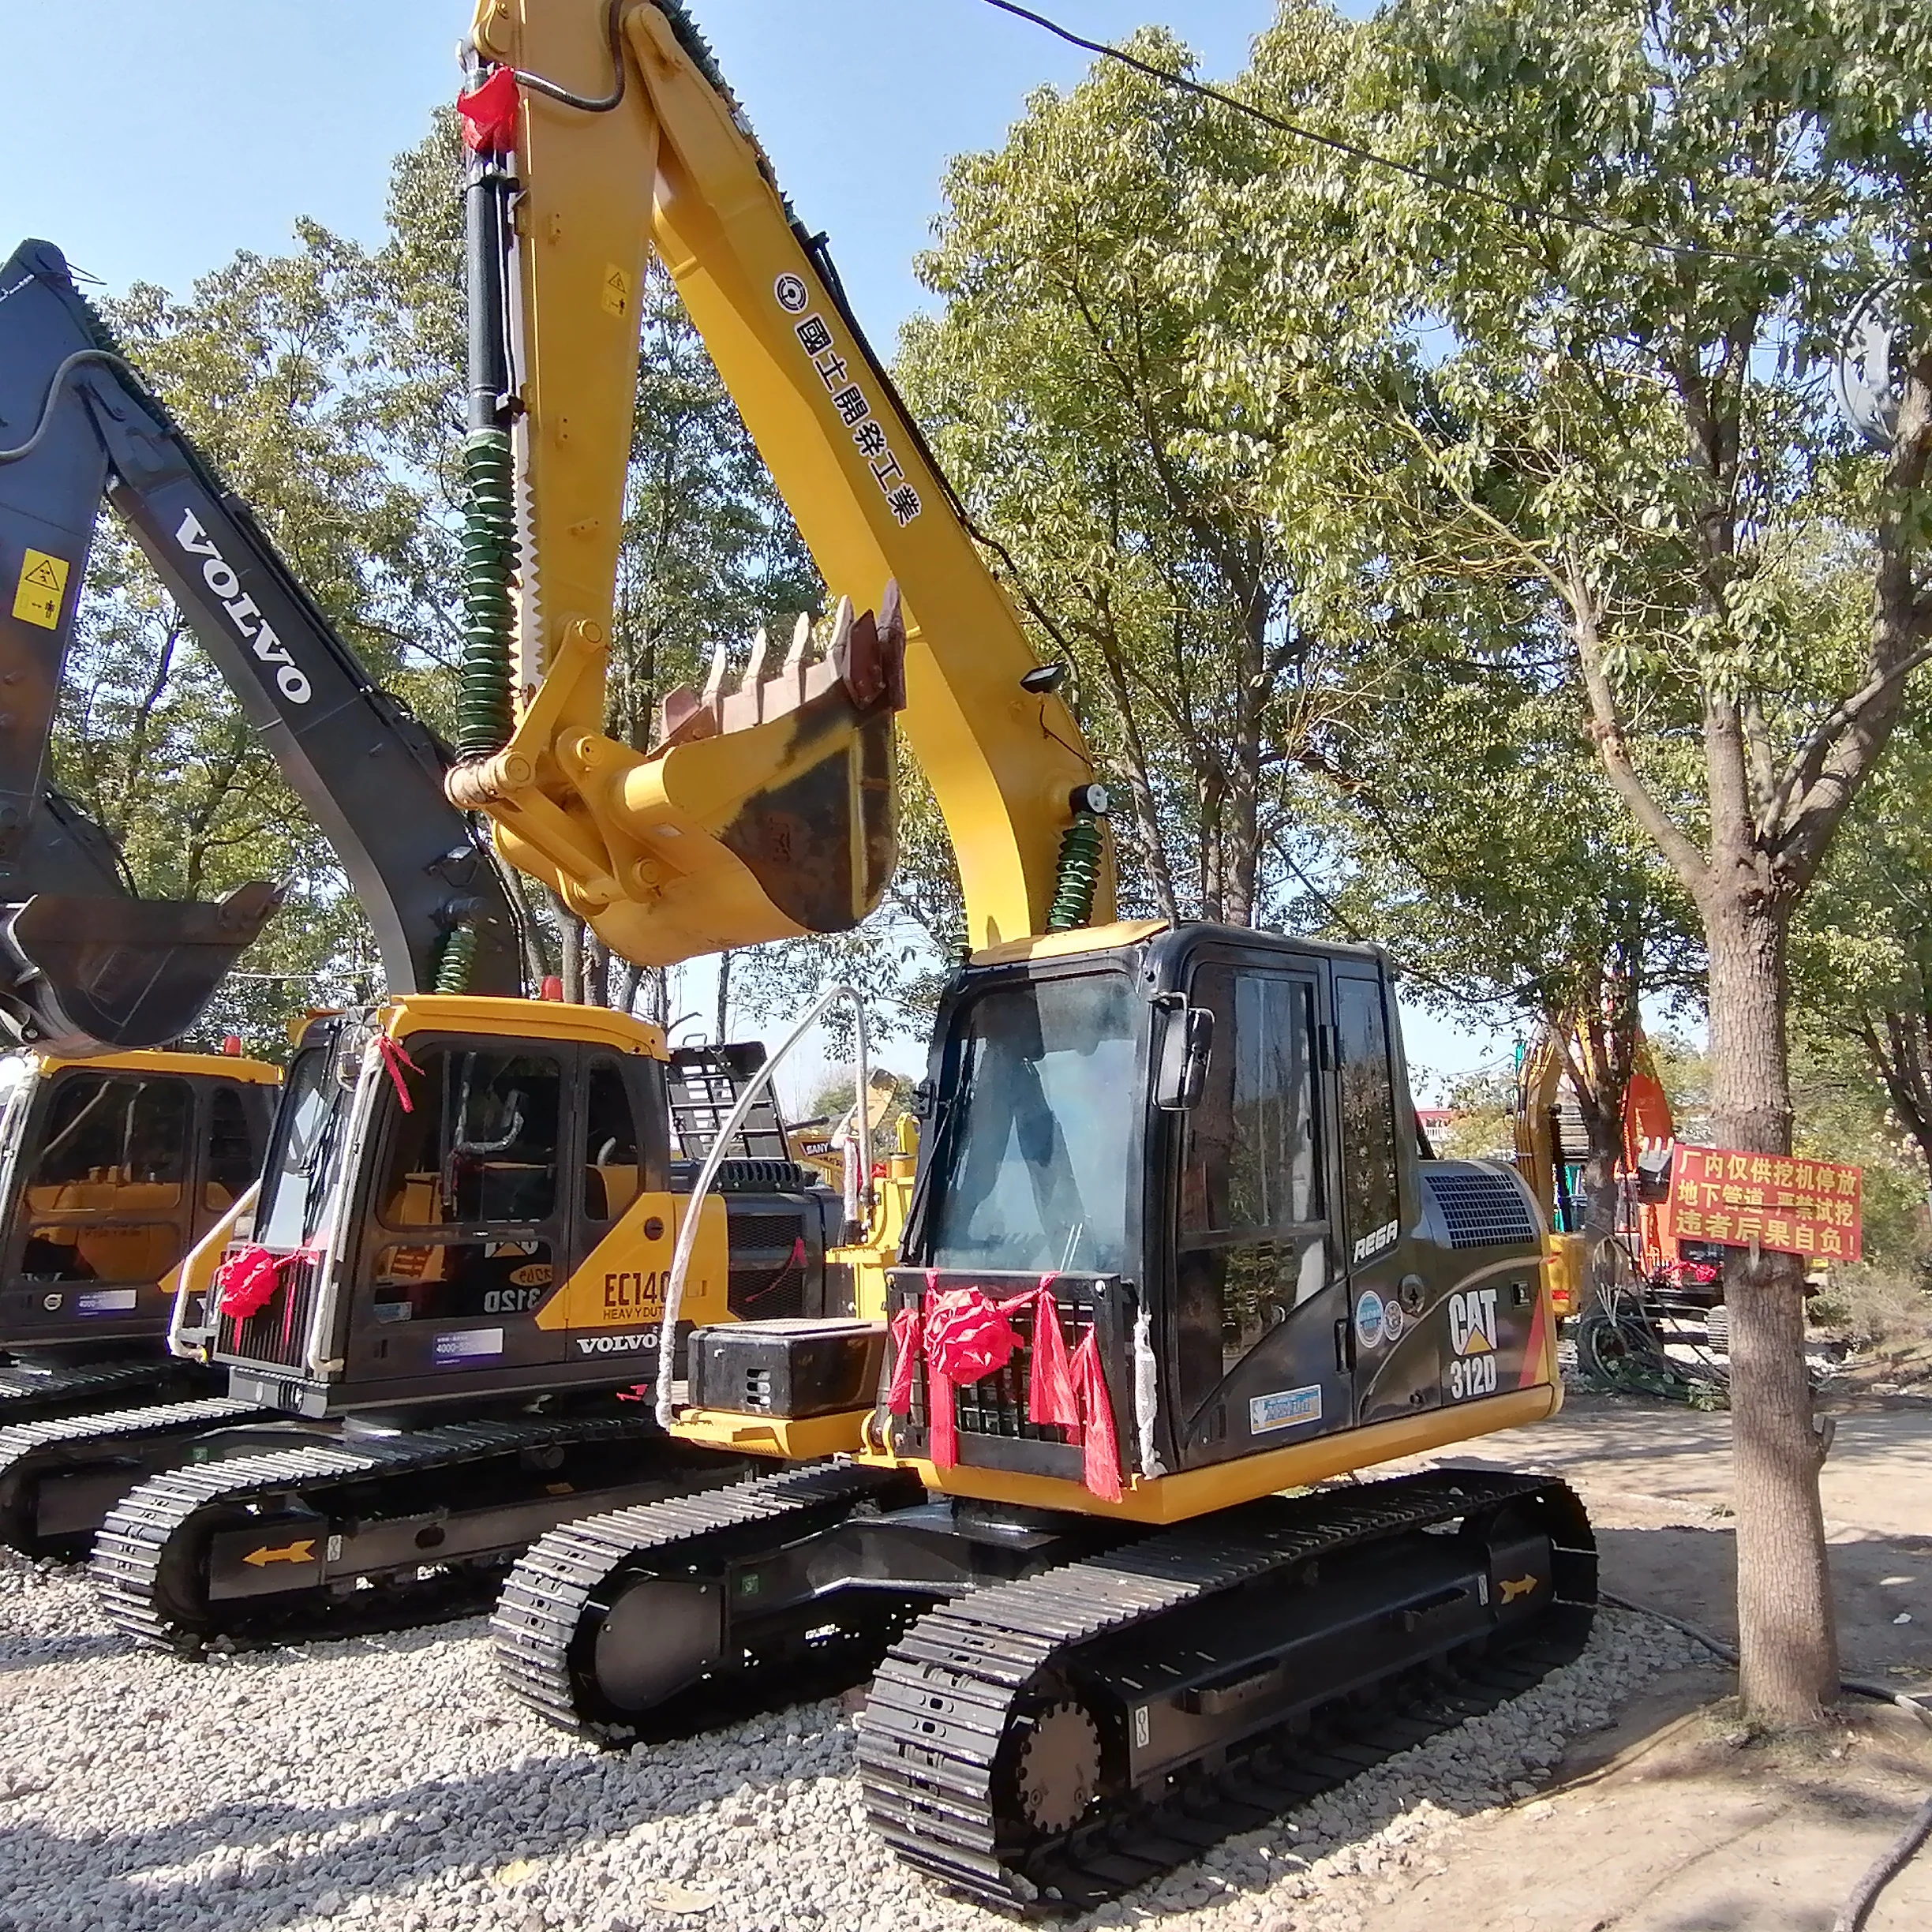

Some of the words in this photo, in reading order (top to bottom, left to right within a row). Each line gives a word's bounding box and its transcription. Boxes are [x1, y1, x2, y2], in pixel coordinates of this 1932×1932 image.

[795, 314, 921, 527] 國土開発工業
[175, 507, 312, 704] VOLVO
[807, 1143, 828, 1154] SANY
[1679, 1150, 1857, 1197] 厂内仅供挖机停放
[1677, 1179, 1765, 1215] 地下管道
[1777, 1191, 1855, 1227] 严禁试挖
[577, 1333, 658, 1354] VOLVO
[1448, 1289, 1498, 1356] CAT
[1450, 1354, 1497, 1399] 312D
